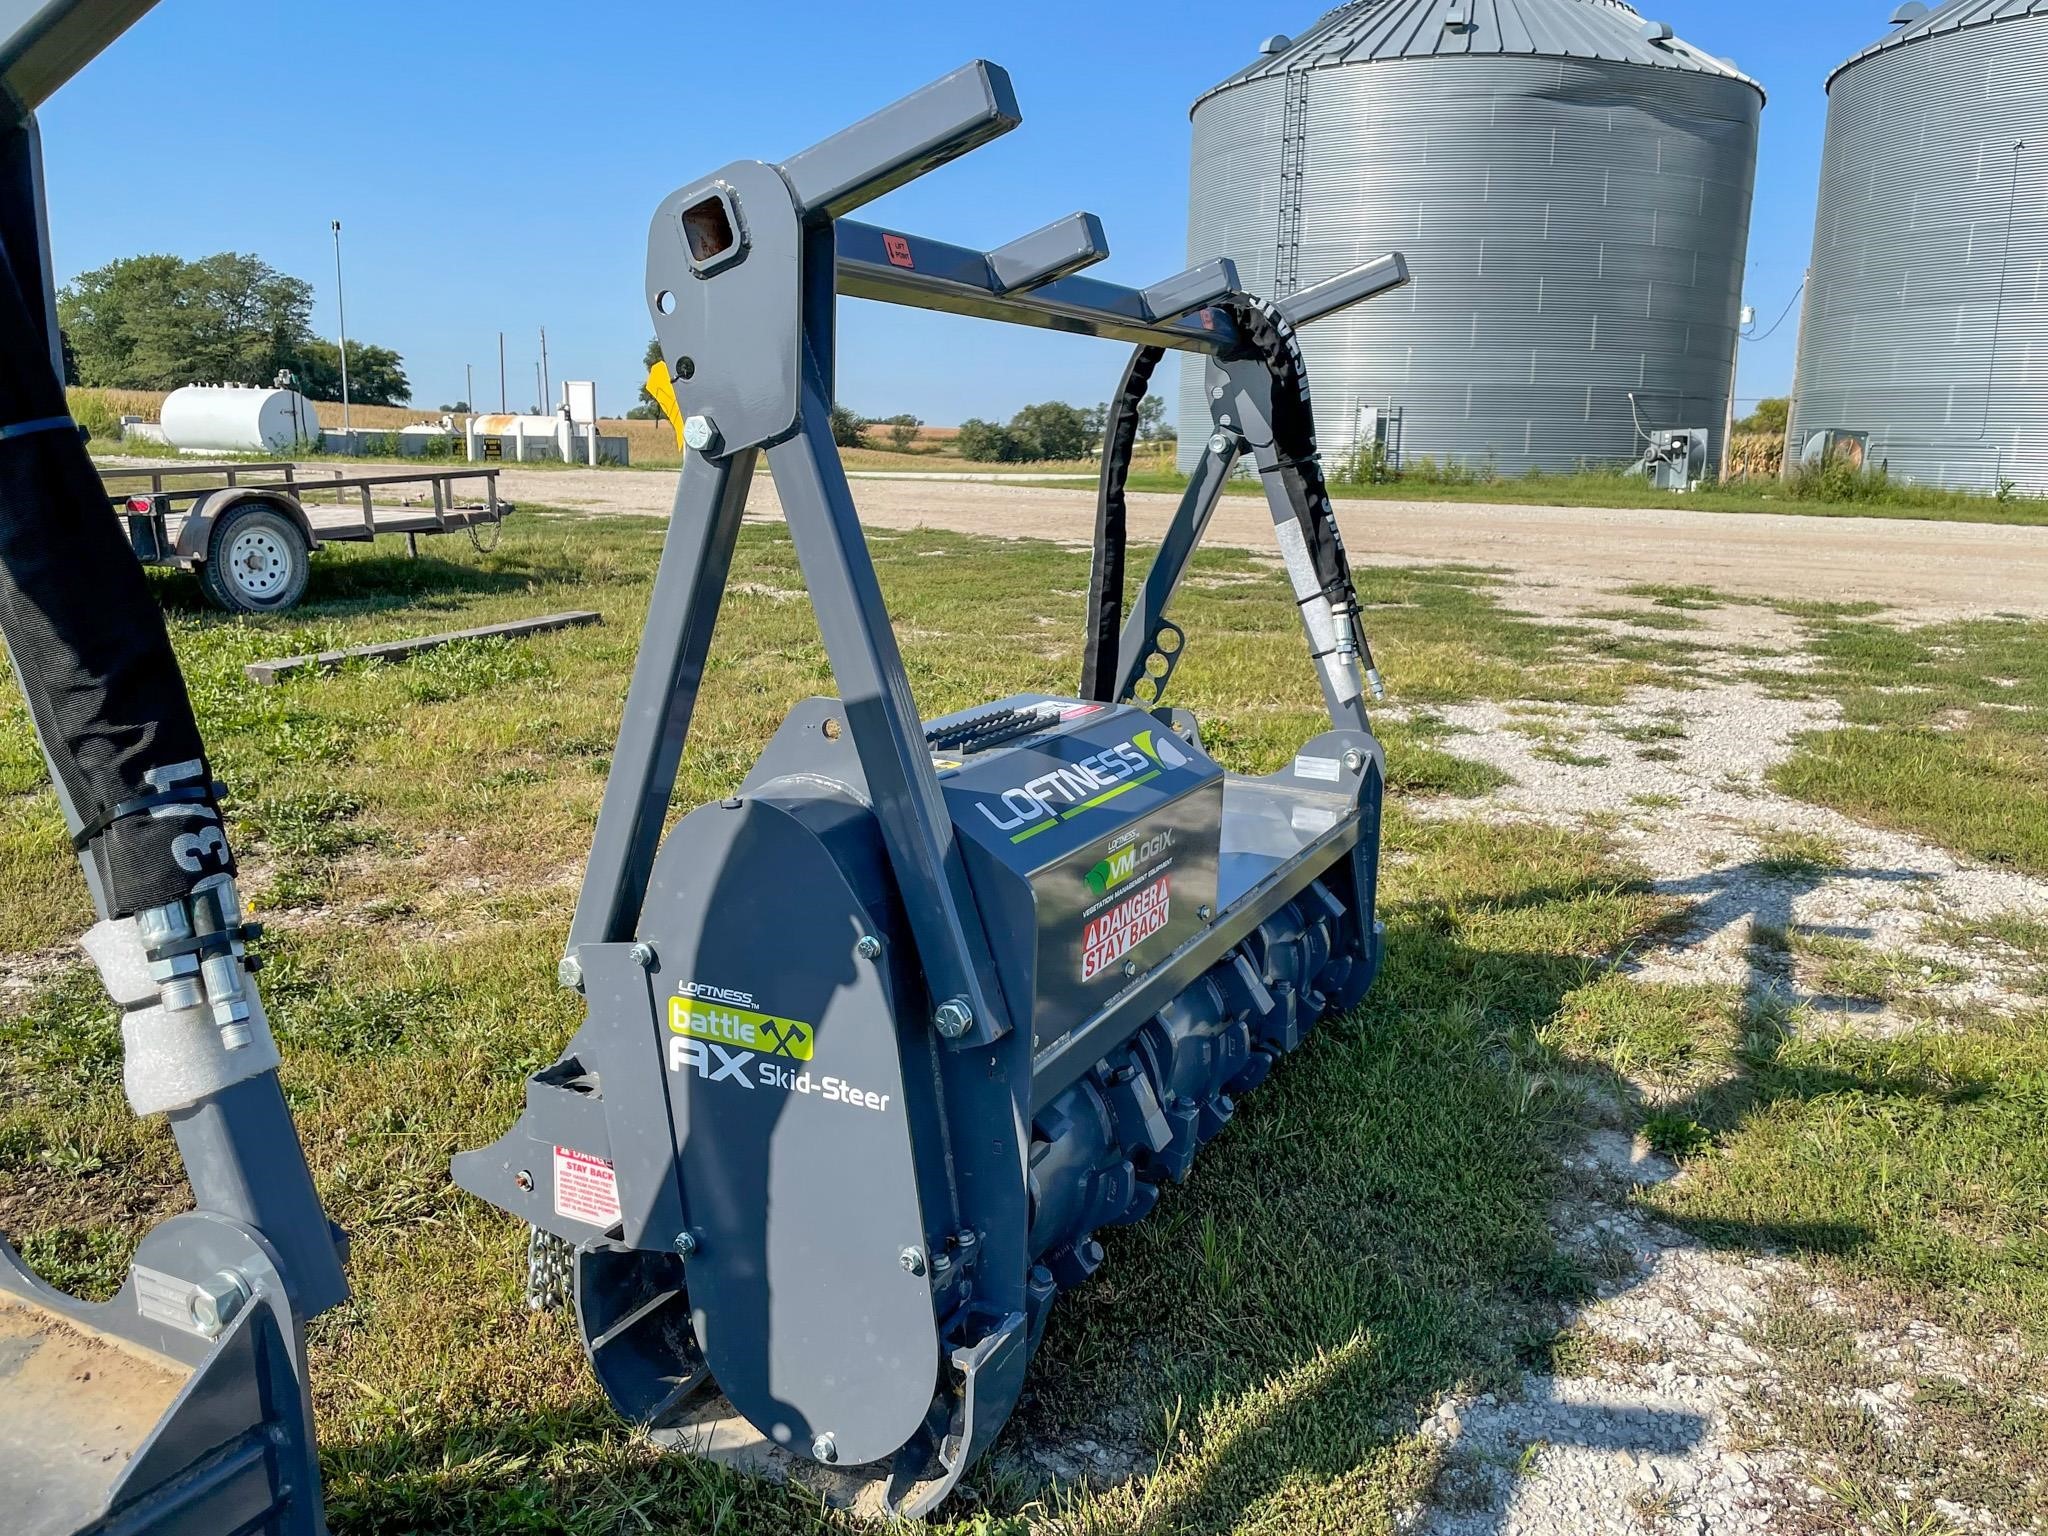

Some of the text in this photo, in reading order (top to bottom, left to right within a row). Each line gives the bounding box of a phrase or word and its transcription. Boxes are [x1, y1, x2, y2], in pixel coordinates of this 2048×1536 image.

[975, 741, 1149, 830] LOFTNESS
[1108, 829, 1137, 851] LOFTNESS
[1082, 857, 1173, 918] VEGETATION MANAGEMENT EQUIPMENT
[1099, 884, 1158, 941] DANGER
[1085, 903, 1167, 977] STAY BACK
[678, 980, 753, 1003] LOFTNESS
[673, 1003, 755, 1043] battle
[669, 1036, 890, 1111] AX Skid-Steer
[566, 1161, 614, 1181] STAY BACK
